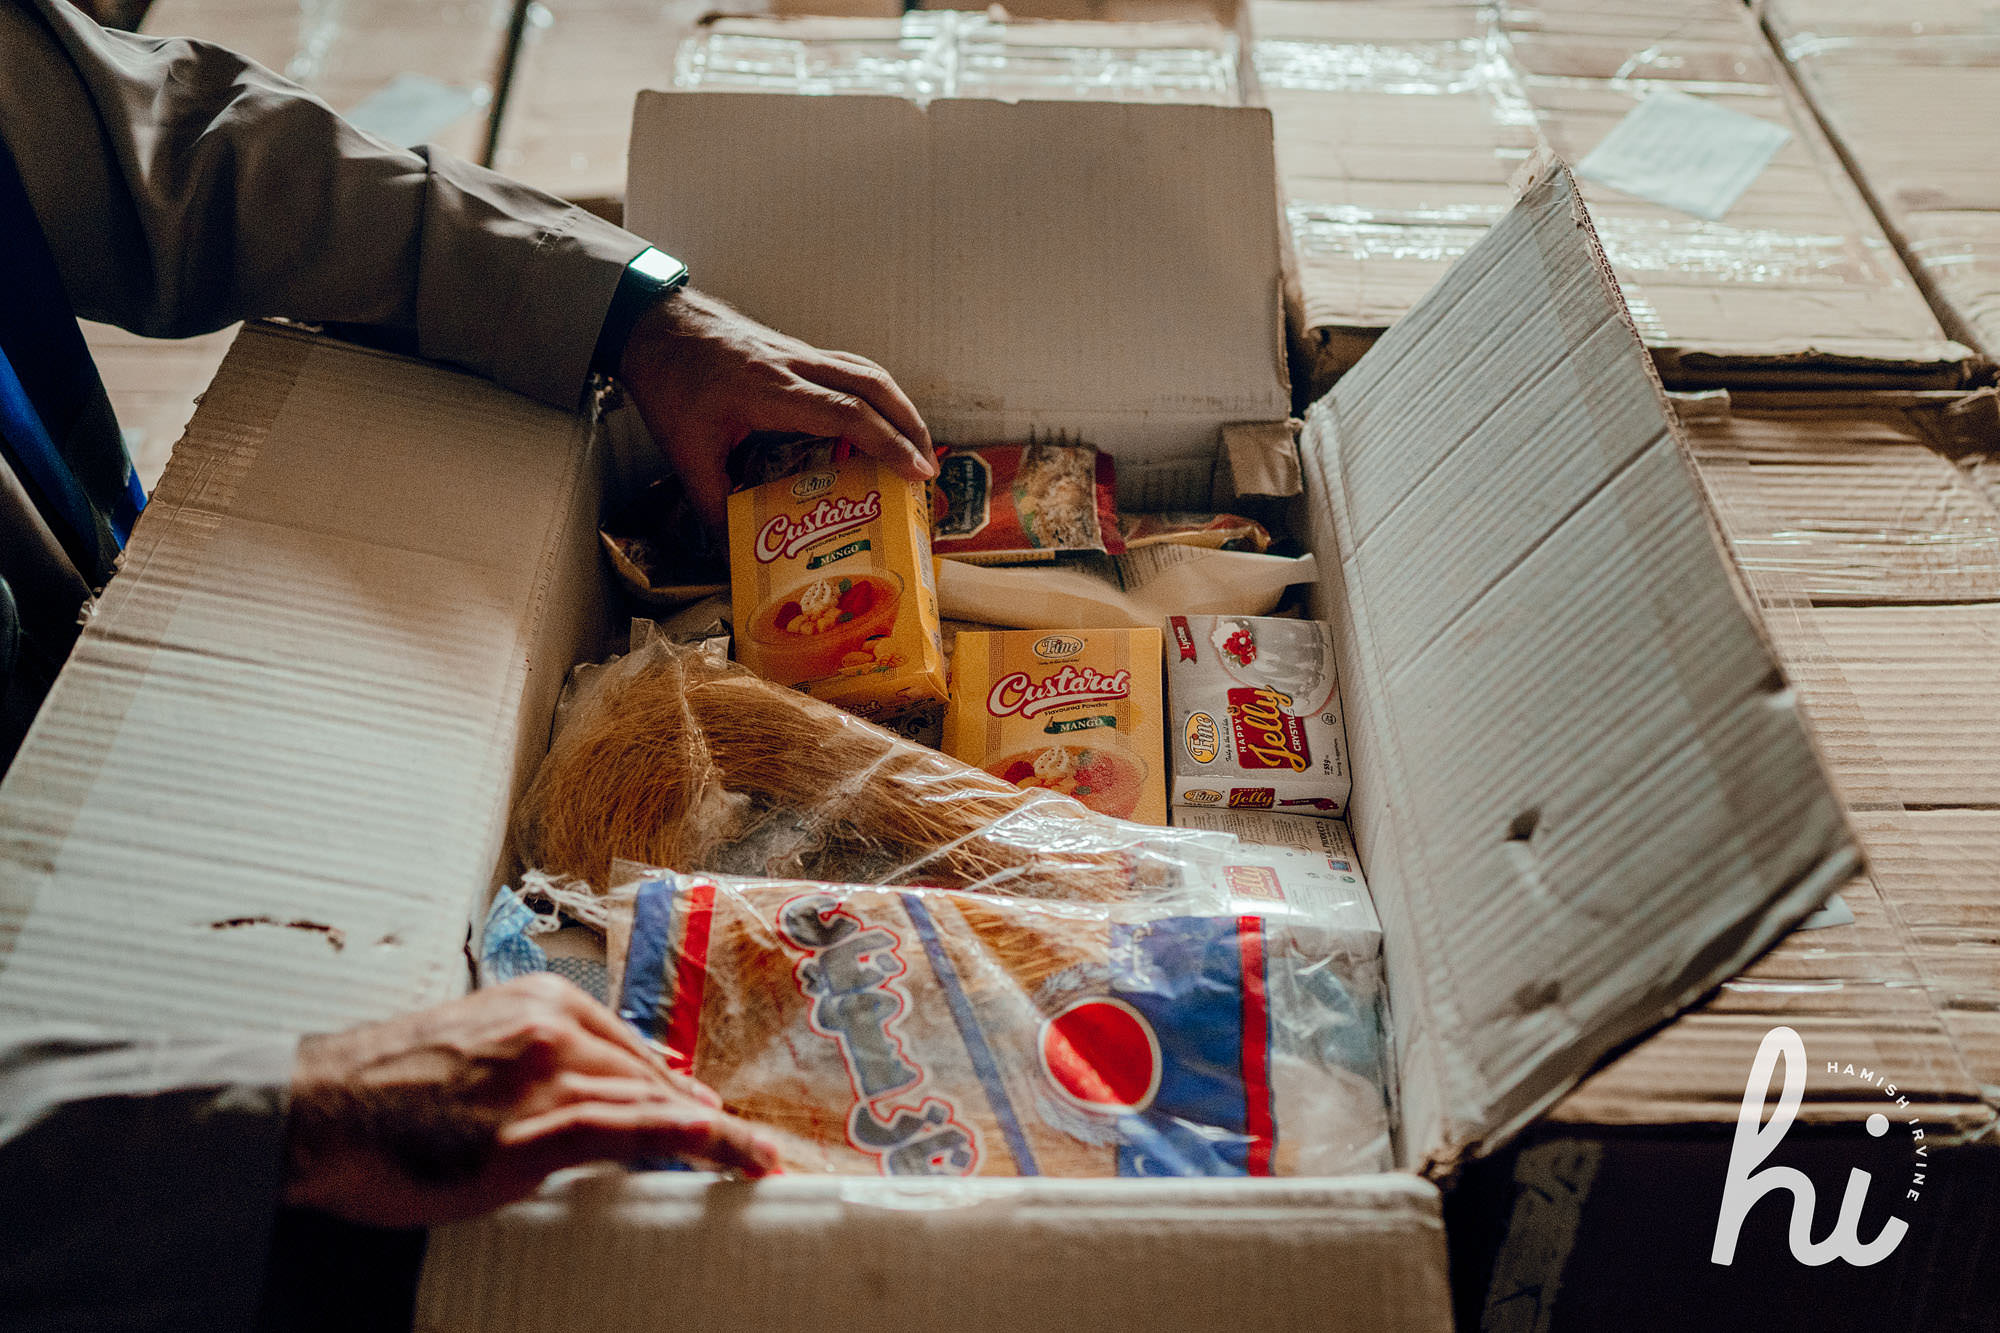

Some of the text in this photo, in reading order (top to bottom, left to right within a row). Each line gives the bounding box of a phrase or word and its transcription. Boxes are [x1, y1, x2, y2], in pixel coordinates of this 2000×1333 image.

[754, 491, 882, 564] Custard
[820, 543, 860, 565] MANGO
[1041, 638, 1081, 656] Fine
[986, 666, 1131, 719] Custard
[1060, 718, 1105, 732] MANGO
[1191, 716, 1215, 757] Fine
[1234, 717, 1247, 753] HAPPY
[1240, 685, 1308, 774] Jelly
[1285, 707, 1302, 752] CRYSTALS
[1230, 790, 1274, 807] Jelly
